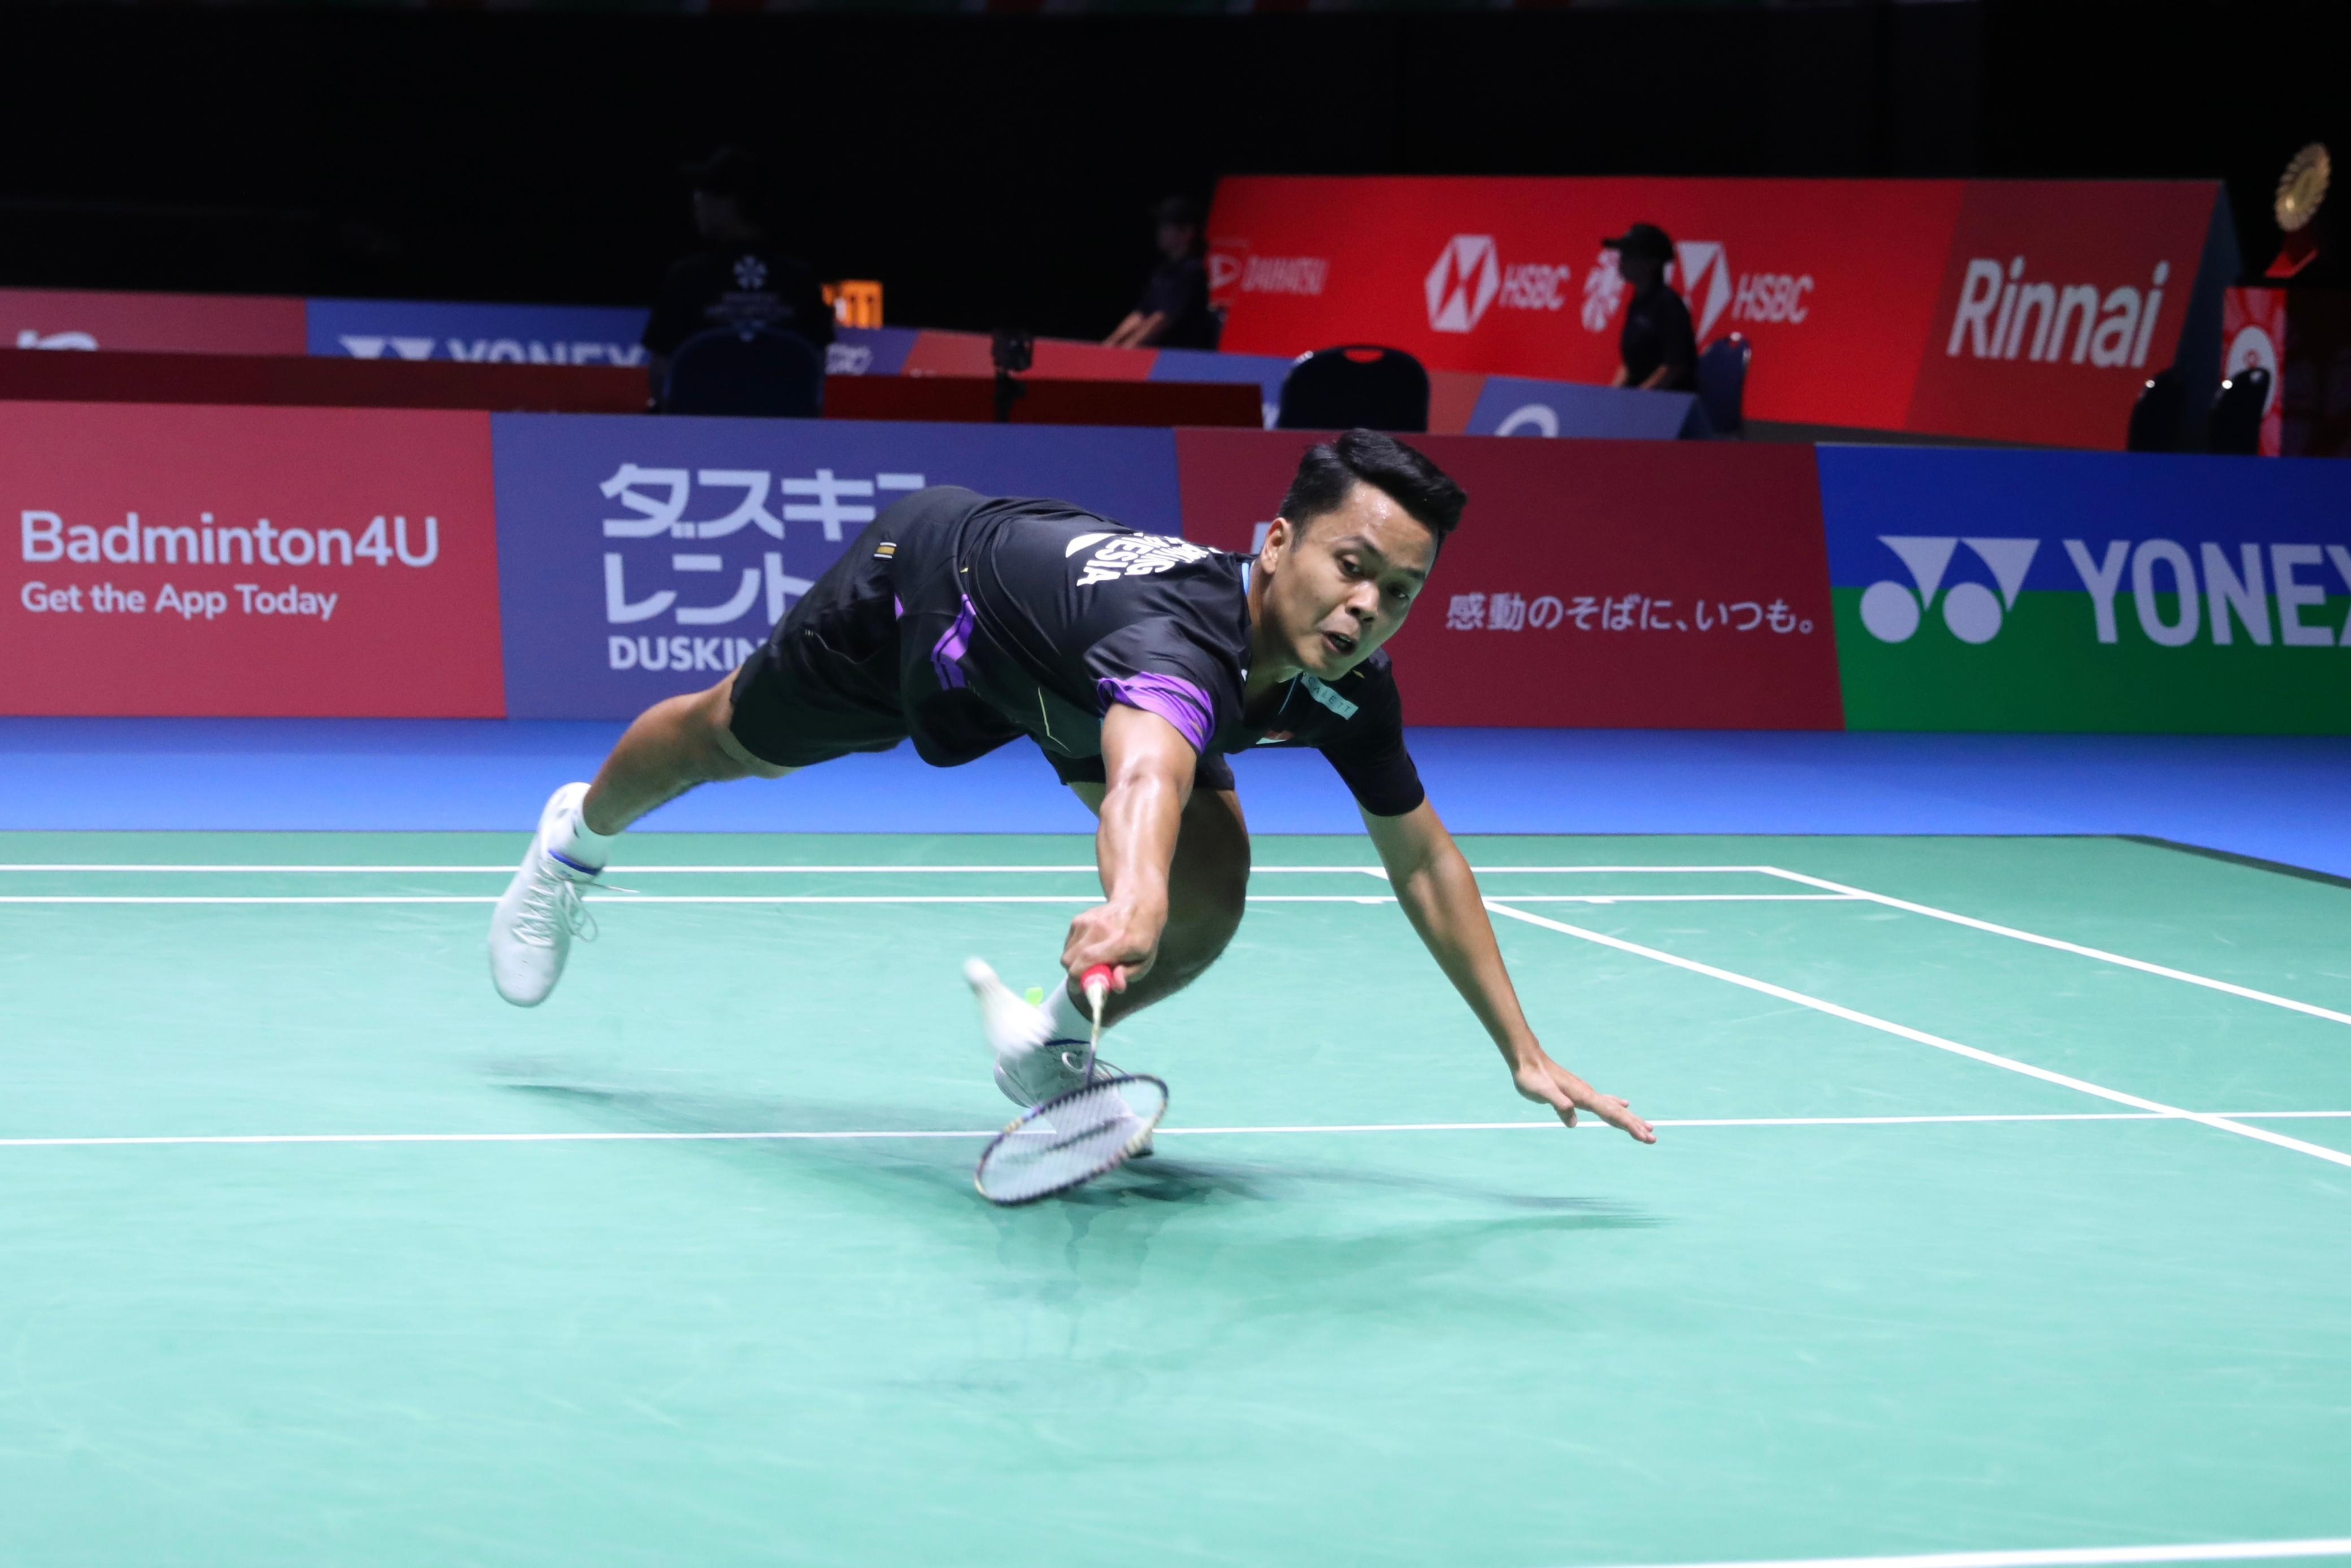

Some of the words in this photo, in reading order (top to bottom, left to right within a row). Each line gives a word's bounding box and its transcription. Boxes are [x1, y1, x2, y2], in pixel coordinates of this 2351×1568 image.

[1499, 264, 1570, 310] HSBC
[1733, 274, 1814, 324] HSBC
[1947, 257, 2169, 368] Rinnai
[600, 463, 924, 541] ダスキ
[21, 510, 439, 568] Badminton4U
[21, 581, 83, 612] Get
[89, 582, 146, 613] the
[154, 583, 228, 620] App
[234, 583, 338, 621] Today
[1446, 592, 1812, 633] 感動のそばに、いつも。
